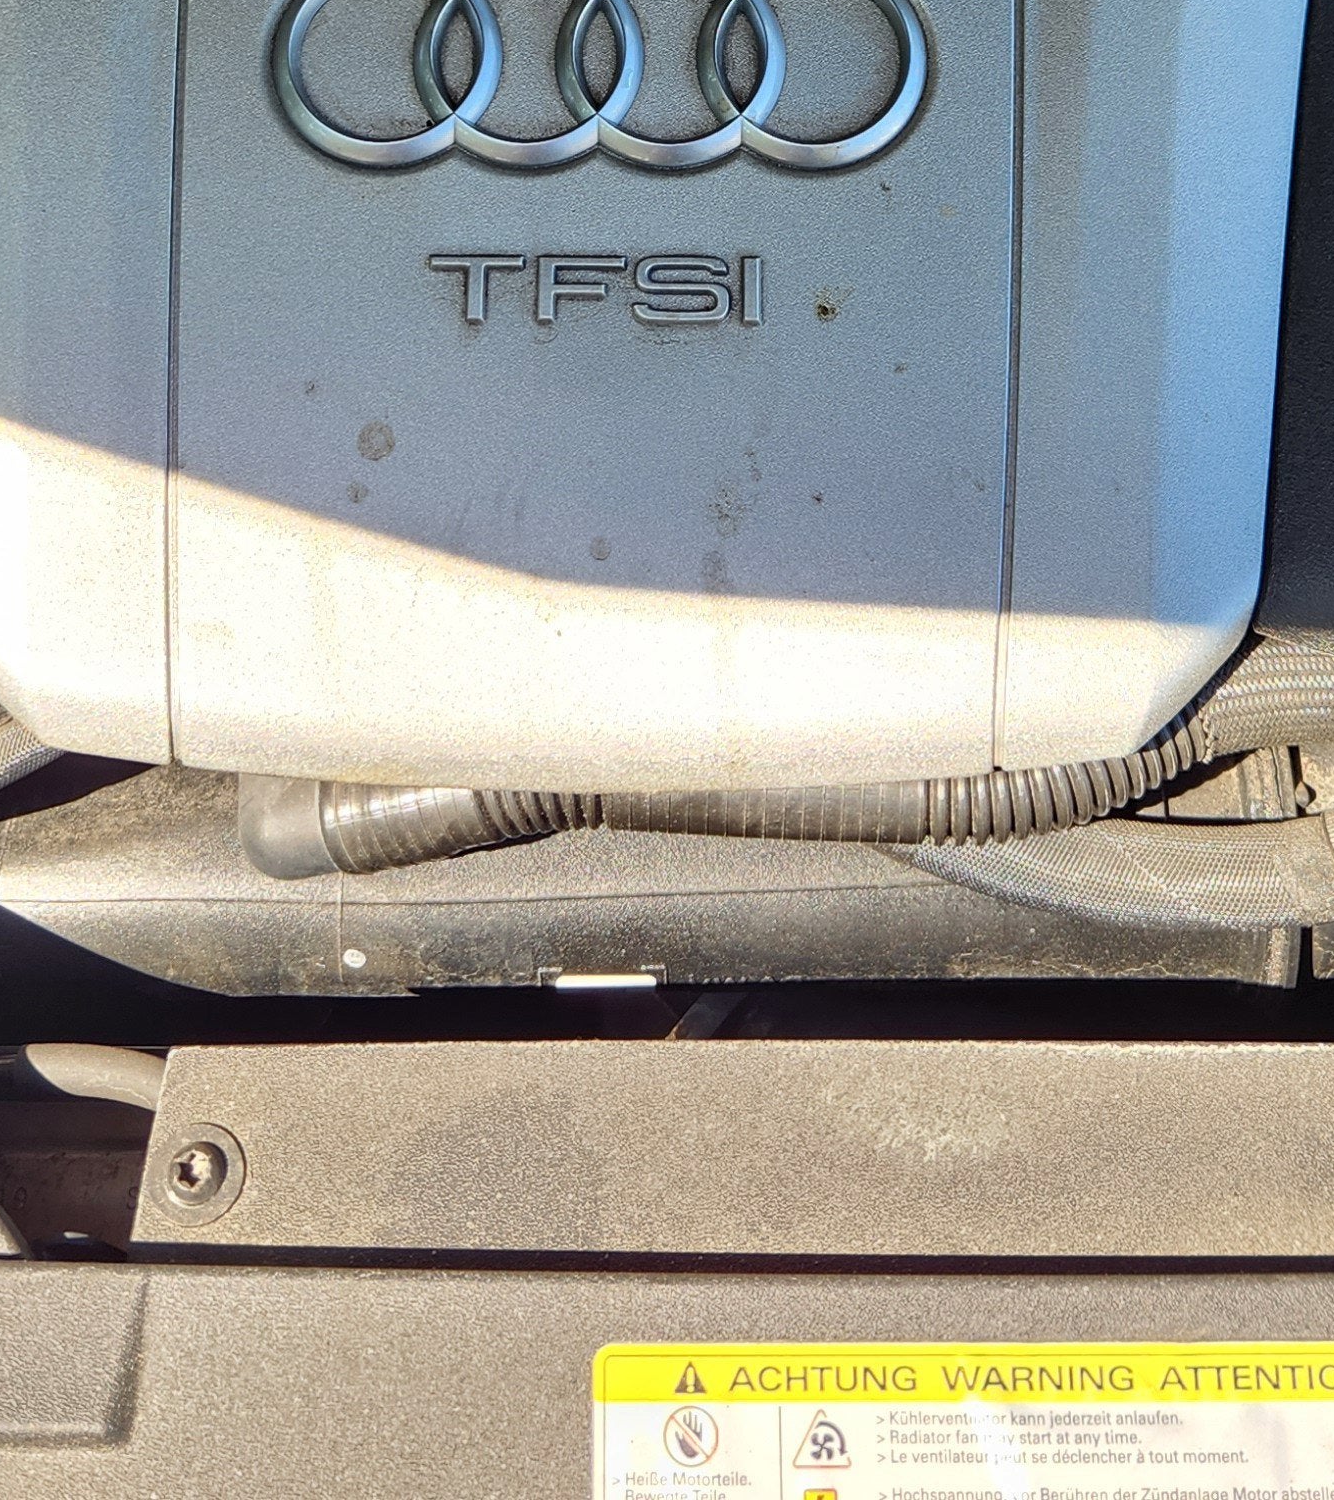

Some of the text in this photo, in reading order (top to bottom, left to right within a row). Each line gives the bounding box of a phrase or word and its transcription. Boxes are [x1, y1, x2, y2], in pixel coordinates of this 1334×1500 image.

[427, 252, 765, 327] TFSI
[729, 1365, 918, 1392] ACHTUNG
[941, 1365, 1134, 1392] WARNING
[889, 1410, 1184, 1429] Kühlerventior kann jederzeit anlaufen.
[889, 1429, 951, 1445] Radiator
[955, 1429, 978, 1445] fan
[1019, 1431, 1053, 1445] start
[1055, 1431, 1071, 1445] at
[1074, 1432, 1101, 1448] any
[1104, 1430, 1143, 1445] time.
[890, 1448, 1249, 1467] Le ventilateur ut se déclencher à tout moment.
[625, 1471, 752, 1486] Heiße Motorteile.
[1113, 1487, 1137, 1500] der
[1233, 1487, 1278, 1500] Motor
